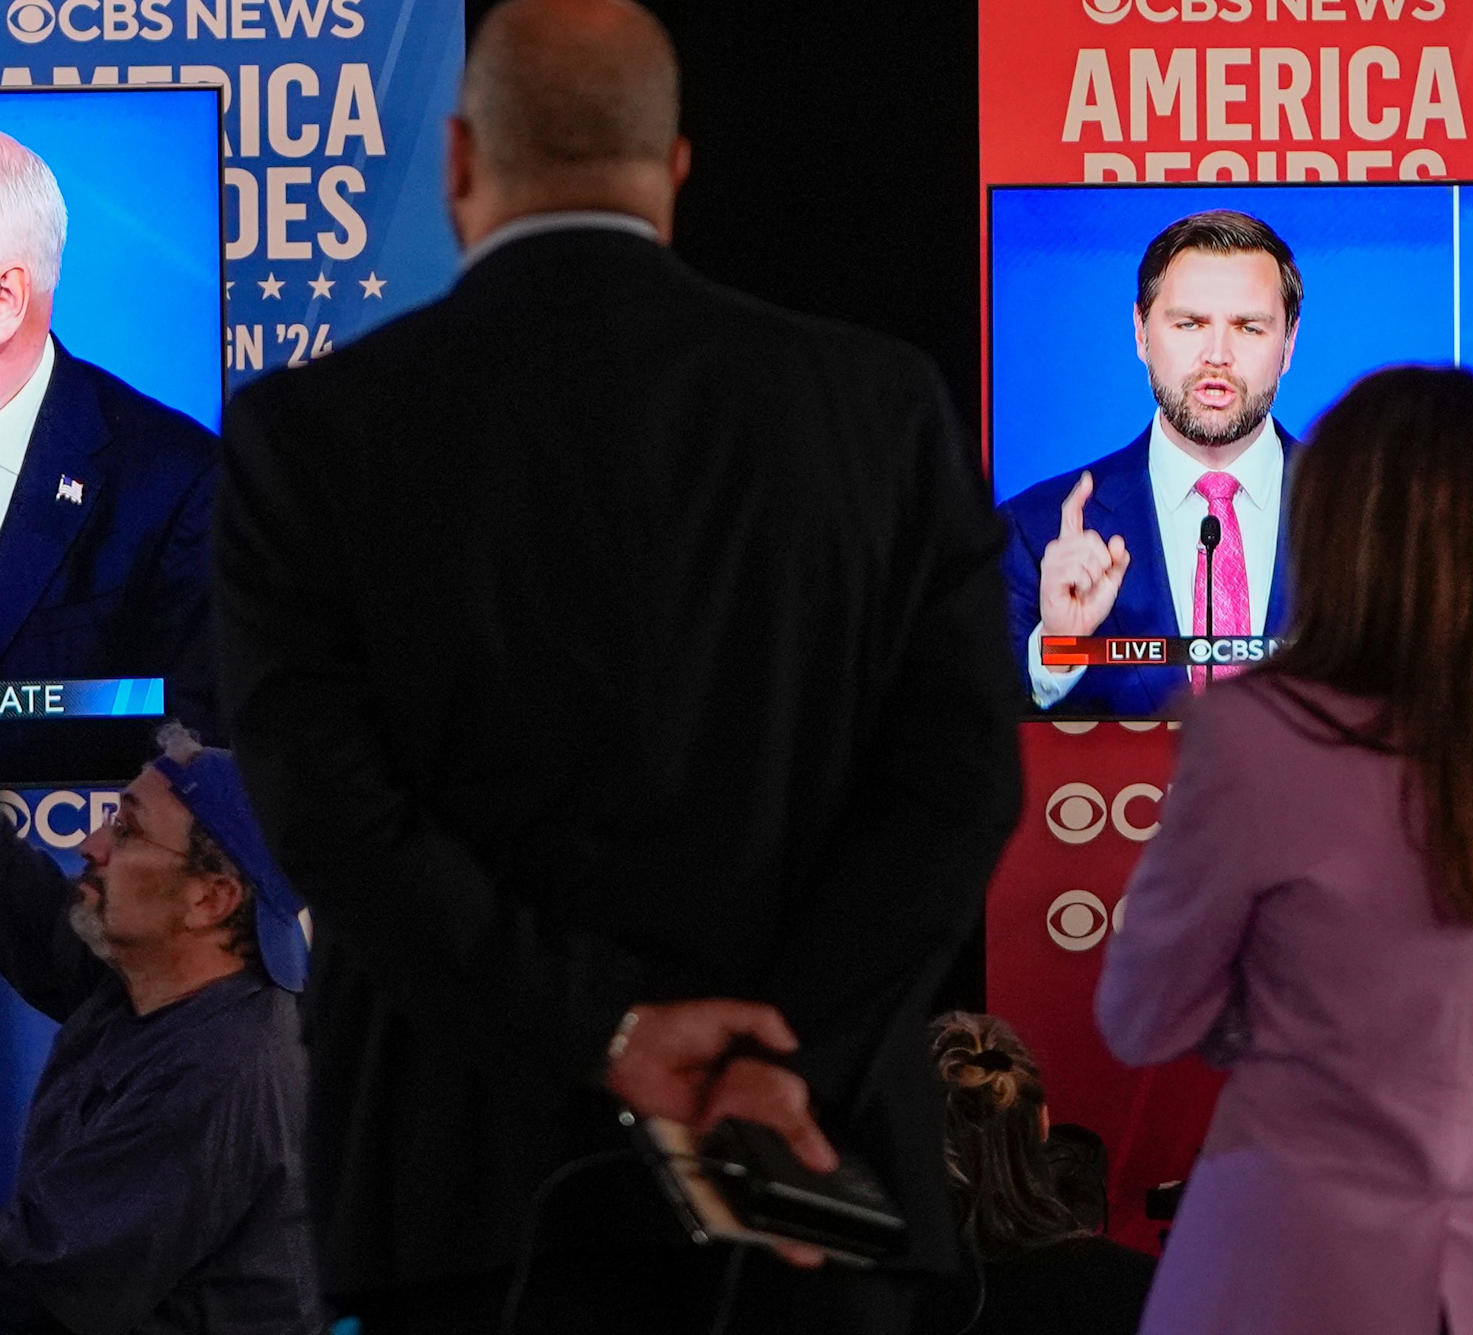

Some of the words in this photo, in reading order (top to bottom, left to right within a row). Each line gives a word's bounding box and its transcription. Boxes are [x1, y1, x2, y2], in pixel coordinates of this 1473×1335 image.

[1061, 45, 1467, 143] AMERICA
[1111, 641, 1162, 661] LIVE
[1212, 639, 1264, 662] CBS
